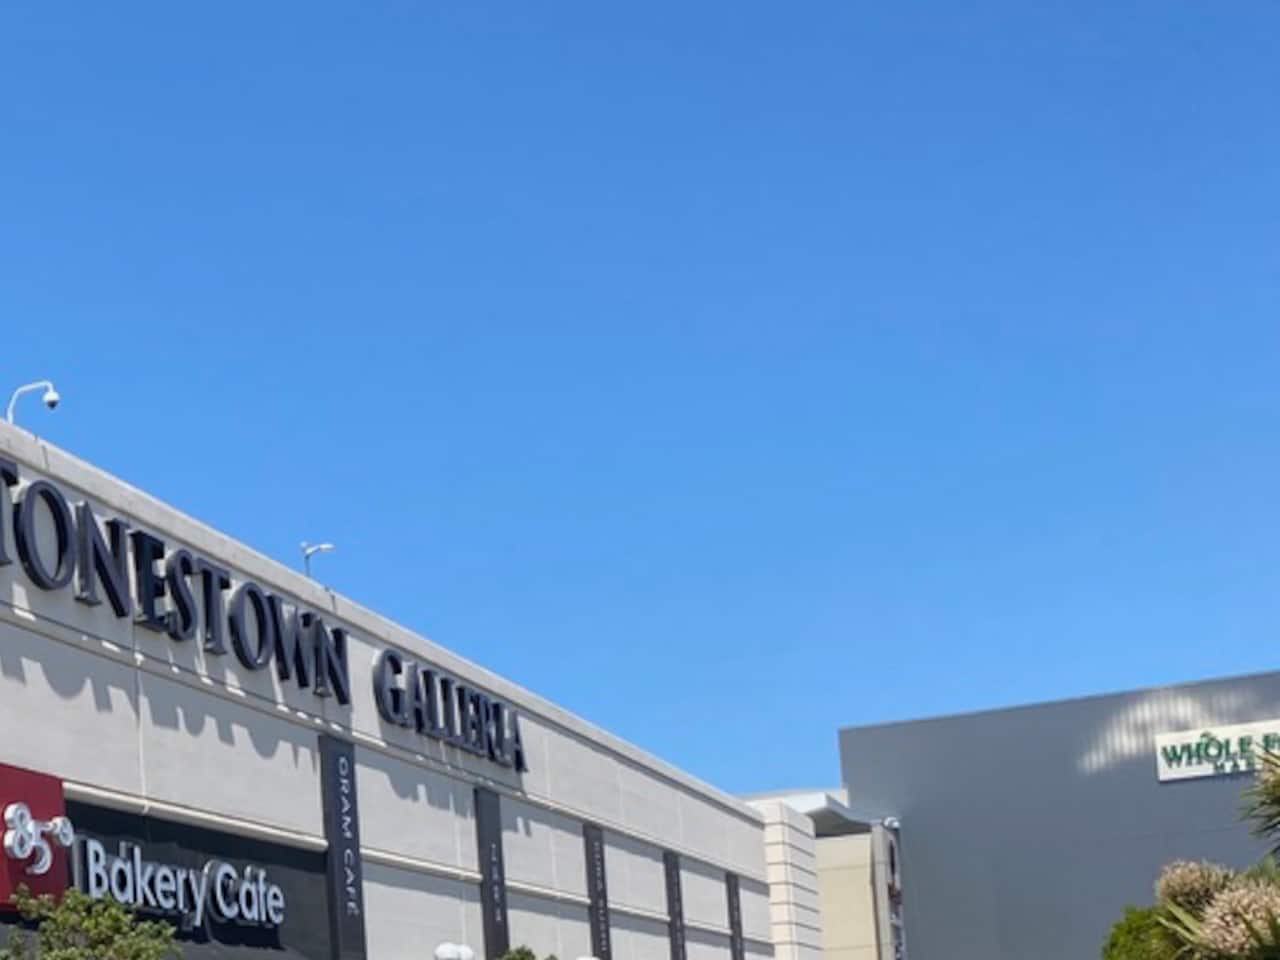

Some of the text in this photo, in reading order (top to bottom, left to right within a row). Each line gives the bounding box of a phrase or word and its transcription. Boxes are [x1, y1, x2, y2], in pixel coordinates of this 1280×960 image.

[372, 647, 529, 774] GALLERIA
[1161, 732, 1253, 769] WHOLE
[85, 836, 209, 928] Bakery
